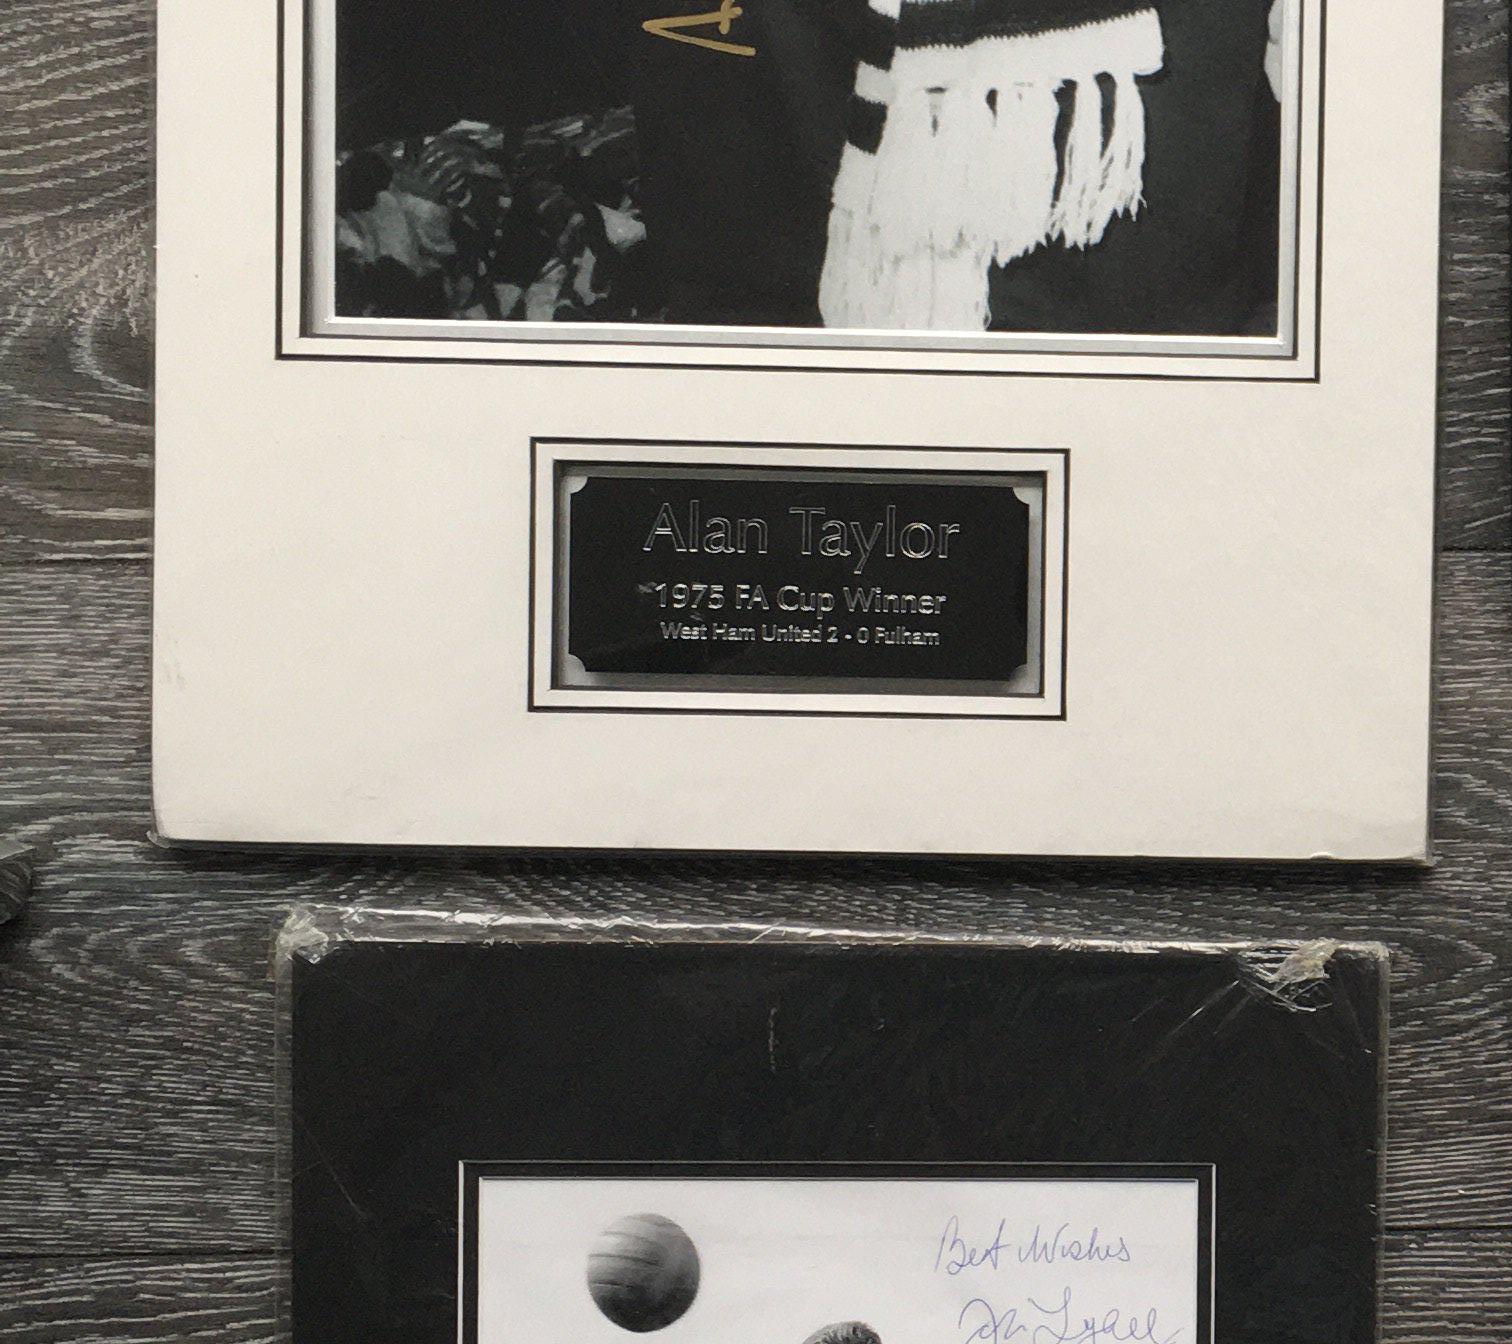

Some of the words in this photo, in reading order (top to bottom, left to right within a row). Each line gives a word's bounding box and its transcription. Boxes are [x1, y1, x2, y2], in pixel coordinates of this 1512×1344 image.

[641, 499, 768, 555] Alan
[788, 505, 961, 574] Taylor
[655, 582, 726, 609] 1975
[735, 584, 770, 610] FA
[777, 585, 835, 620] Cup
[842, 586, 947, 614] Winner
[660, 621, 708, 640] West
[712, 622, 756, 641] Ham
[761, 624, 822, 643] United
[827, 626, 839, 643] 2
[856, 626, 870, 644] 0
[874, 626, 941, 645] Fulham
